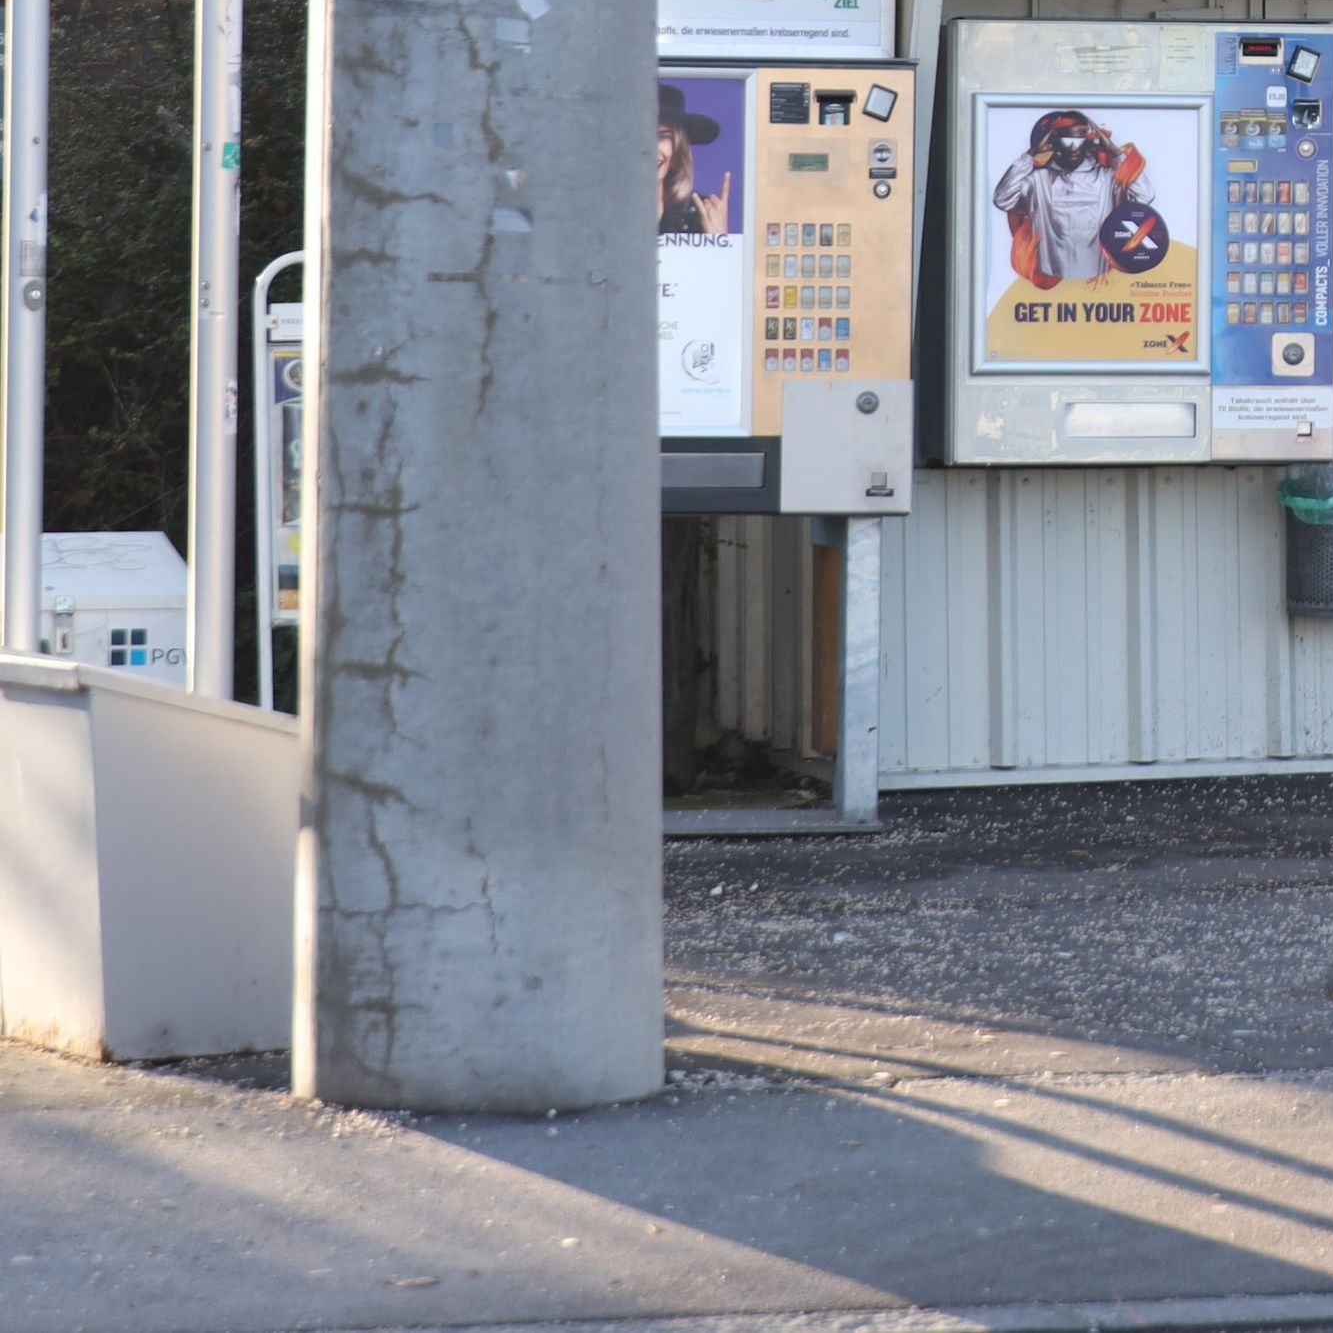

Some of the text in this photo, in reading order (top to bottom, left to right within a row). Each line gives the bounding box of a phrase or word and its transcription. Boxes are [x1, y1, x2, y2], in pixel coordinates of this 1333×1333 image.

[1014, 302, 1192, 323] GET IN YOUR ZONE
[1143, 340, 1168, 349] ZONE
